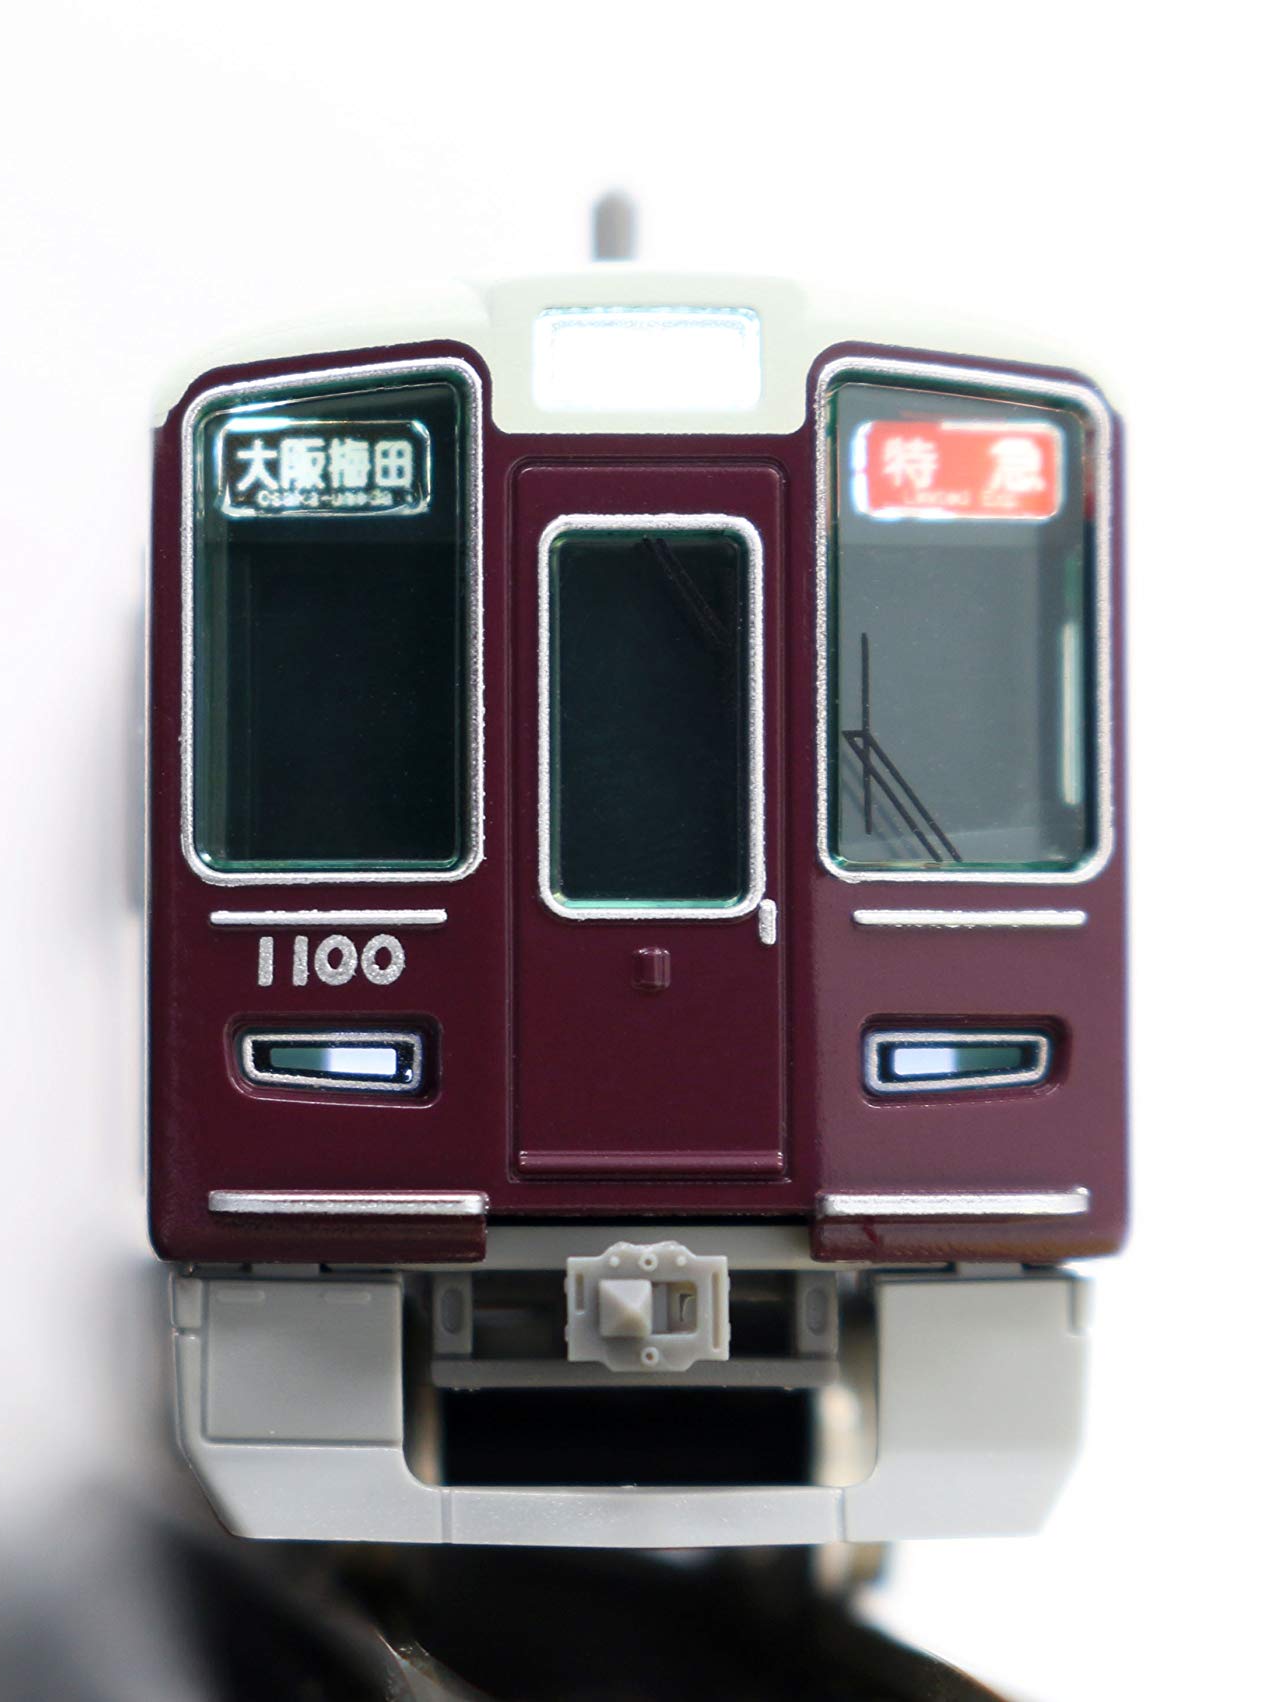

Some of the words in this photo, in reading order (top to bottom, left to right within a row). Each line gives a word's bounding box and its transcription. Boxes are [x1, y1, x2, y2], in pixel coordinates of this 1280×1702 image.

[236, 437, 414, 491] 大阪梅田
[257, 933, 406, 987] 1100
